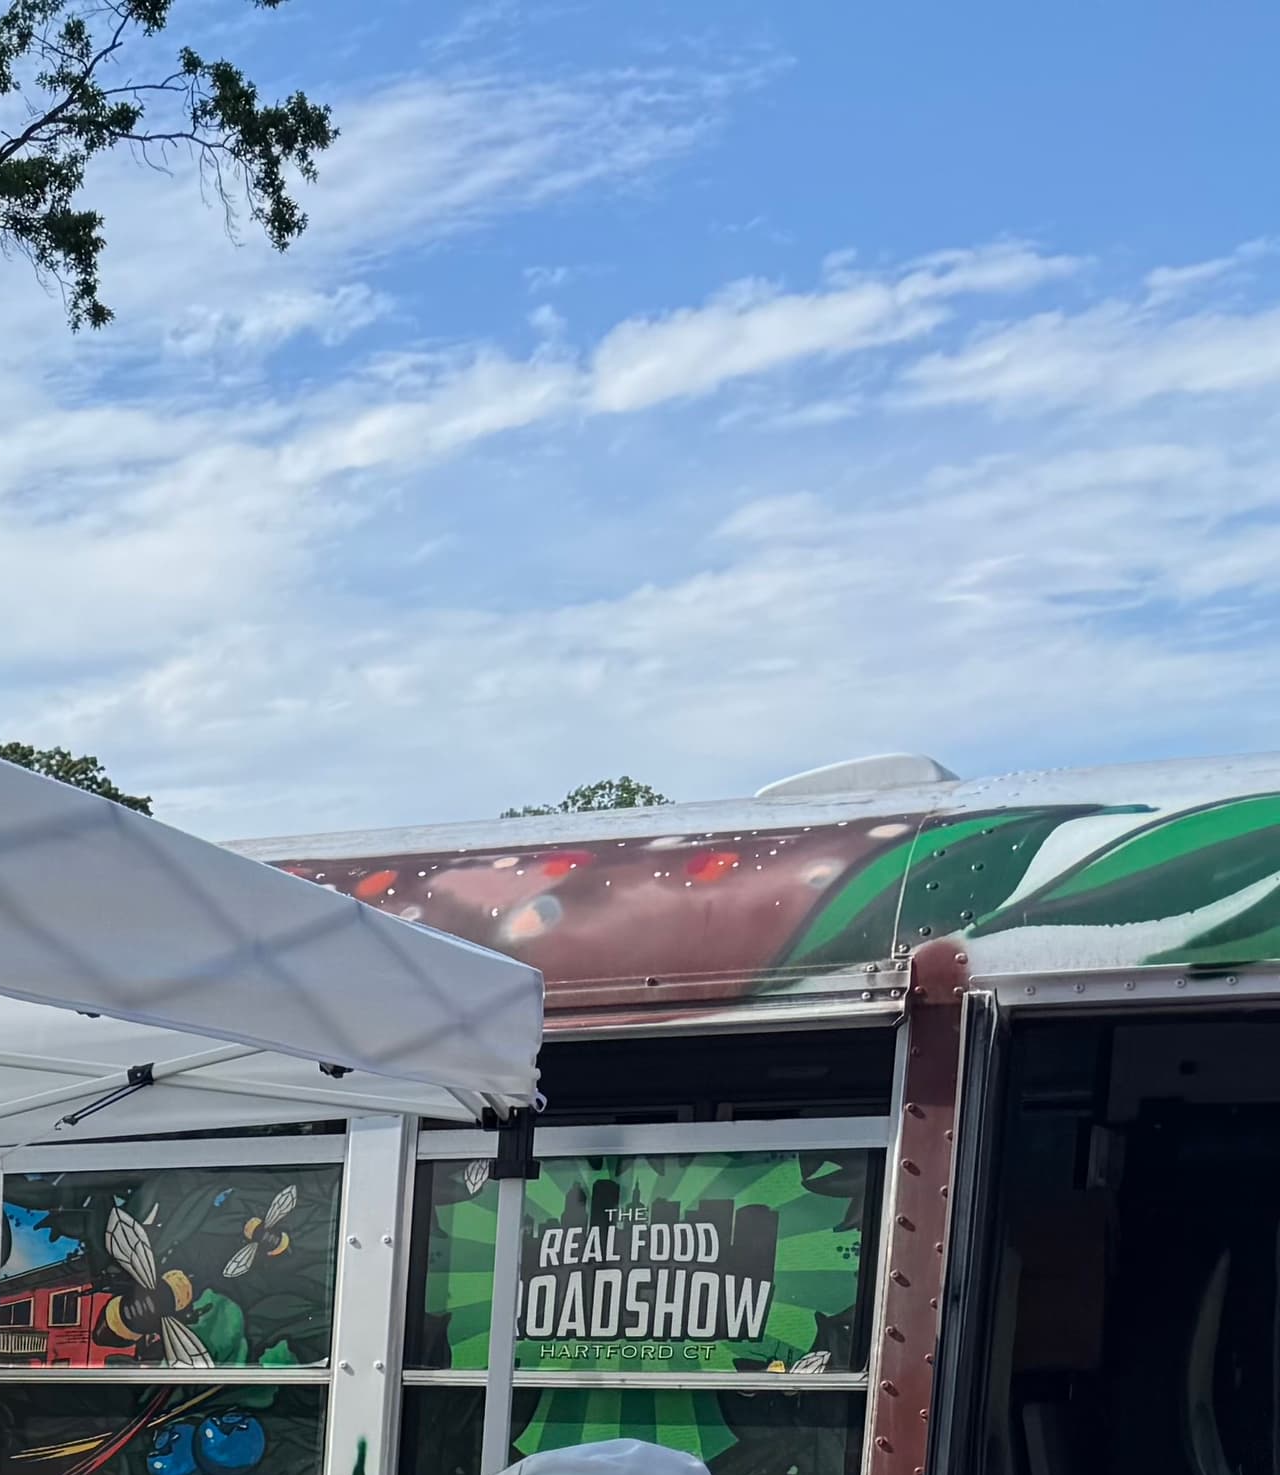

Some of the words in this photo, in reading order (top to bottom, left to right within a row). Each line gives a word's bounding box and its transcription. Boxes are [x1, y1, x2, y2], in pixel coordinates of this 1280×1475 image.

[604, 1207, 648, 1222] THE
[539, 1226, 622, 1268] REAL
[630, 1222, 720, 1263] FOOD
[515, 1268, 771, 1338] OADSHOW
[539, 1344, 674, 1360] HARTFORD
[683, 1344, 716, 1360] CT
